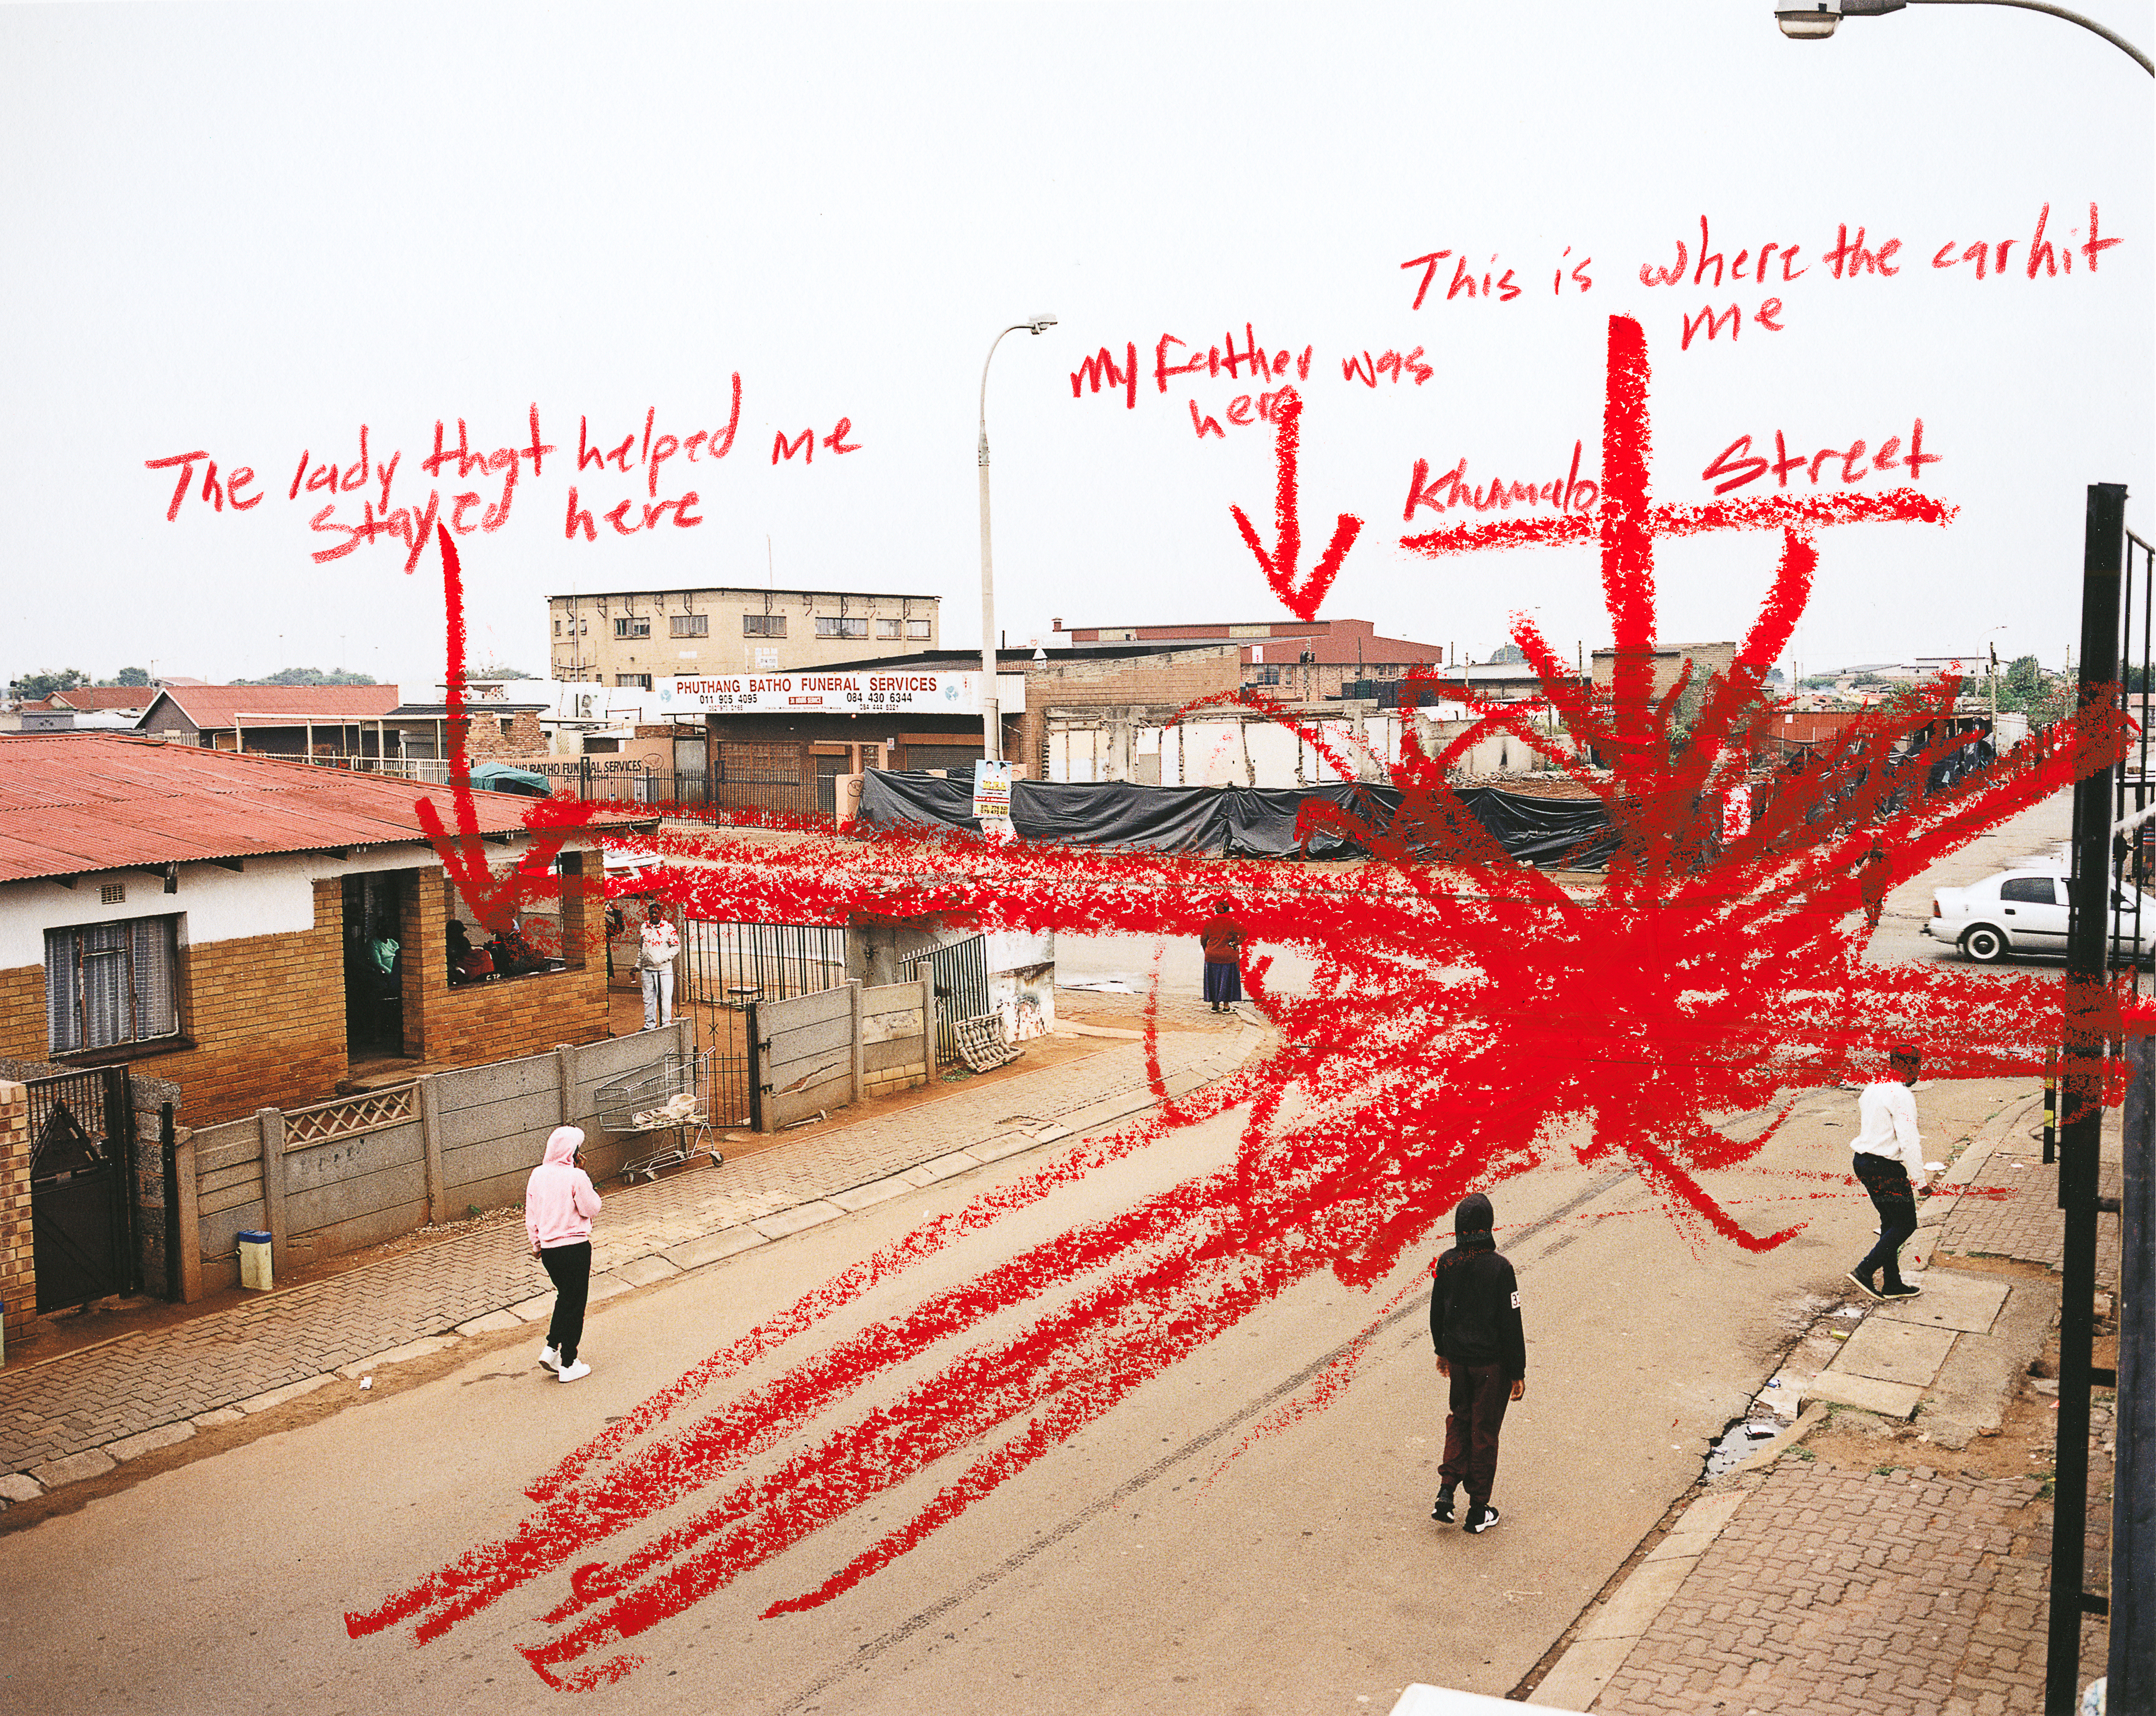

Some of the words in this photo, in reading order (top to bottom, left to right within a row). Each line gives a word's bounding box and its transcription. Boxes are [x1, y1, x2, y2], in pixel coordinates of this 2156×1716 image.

[1400, 249, 1523, 311] This
[1553, 245, 1593, 295] is
[1638, 214, 1811, 288] where
[1820, 222, 1903, 280] the
[1680, 297, 1786, 352] me
[1341, 344, 1435, 389] was
[144, 449, 265, 523] The
[288, 423, 402, 517] lady
[576, 370, 743, 500] helped
[771, 416, 864, 466] me
[1702, 417, 1944, 496] Street
[564, 485, 704, 543] here
[677, 680, 740, 694] PHUTHANG
[750, 678, 791, 692] BATHO
[801, 677, 860, 691] FUNERAL
[870, 677, 937, 691] SERVICES
[700, 694, 713, 704] 011
[719, 694, 733, 704] 905
[738, 694, 757, 704] 4095
[847, 692, 862, 702] 084
[868, 692, 885, 703] 430
[890, 692, 912, 703] 6344
[562, 761, 602, 774] FUNAL
[605, 760, 641, 773] SERVICES
